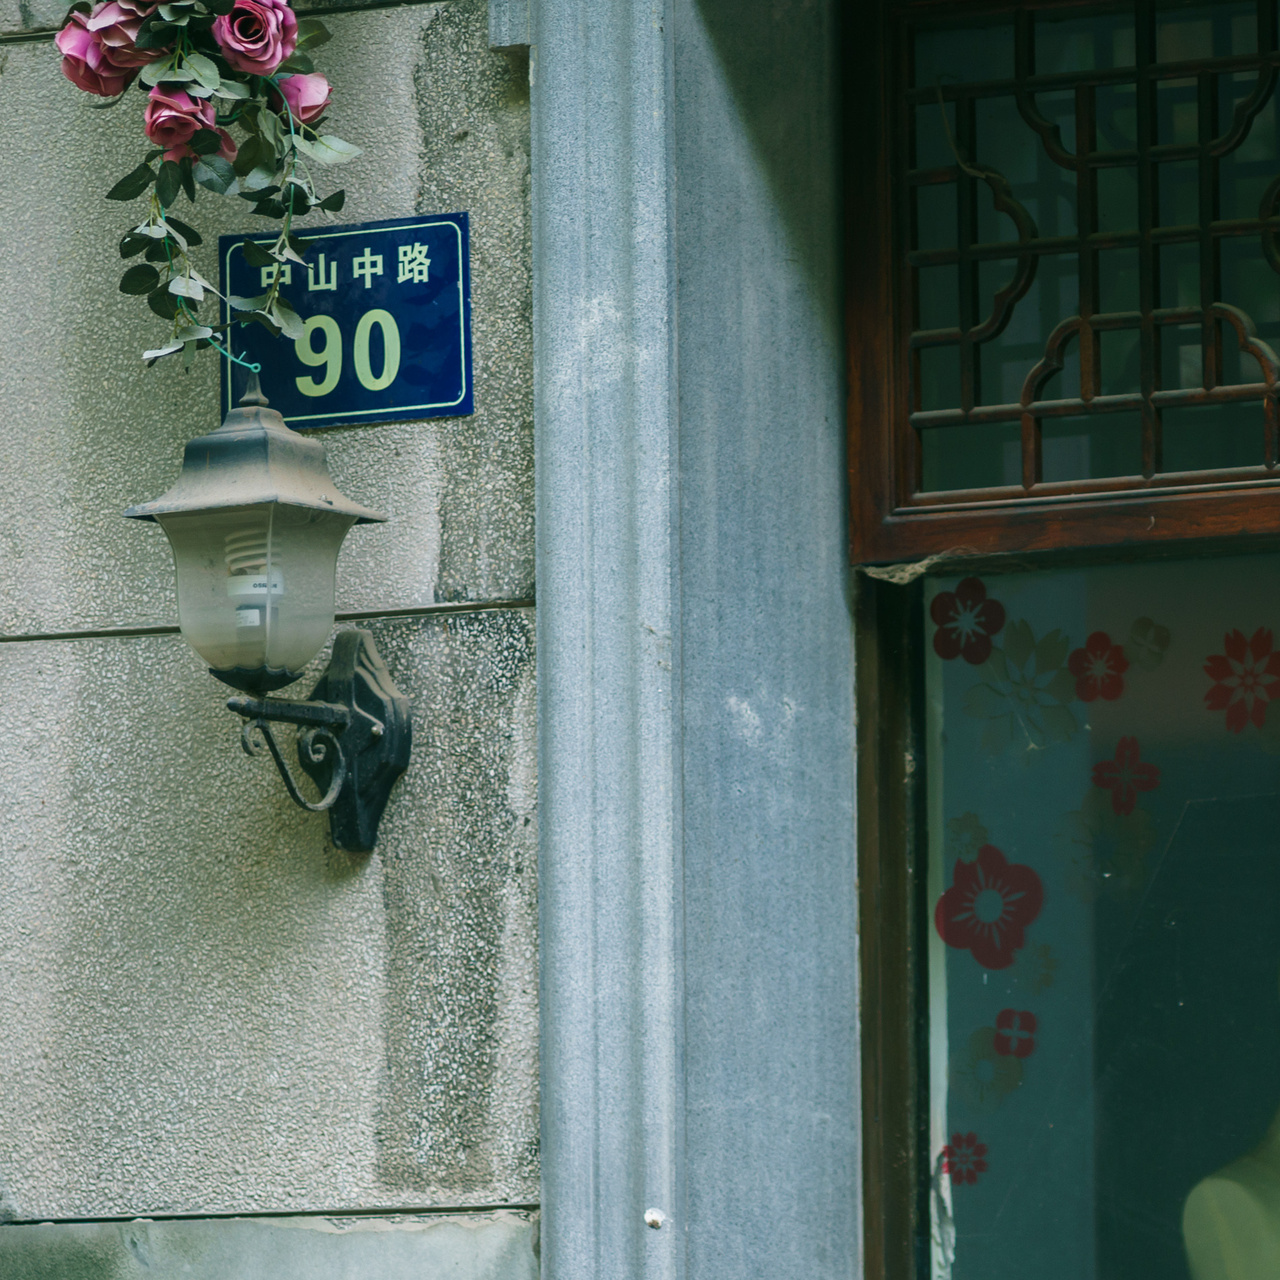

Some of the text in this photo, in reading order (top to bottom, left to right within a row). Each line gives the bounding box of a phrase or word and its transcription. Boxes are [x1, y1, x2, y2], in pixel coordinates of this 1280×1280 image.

[260, 242, 431, 292] 中山中路
[294, 308, 401, 397] 90
